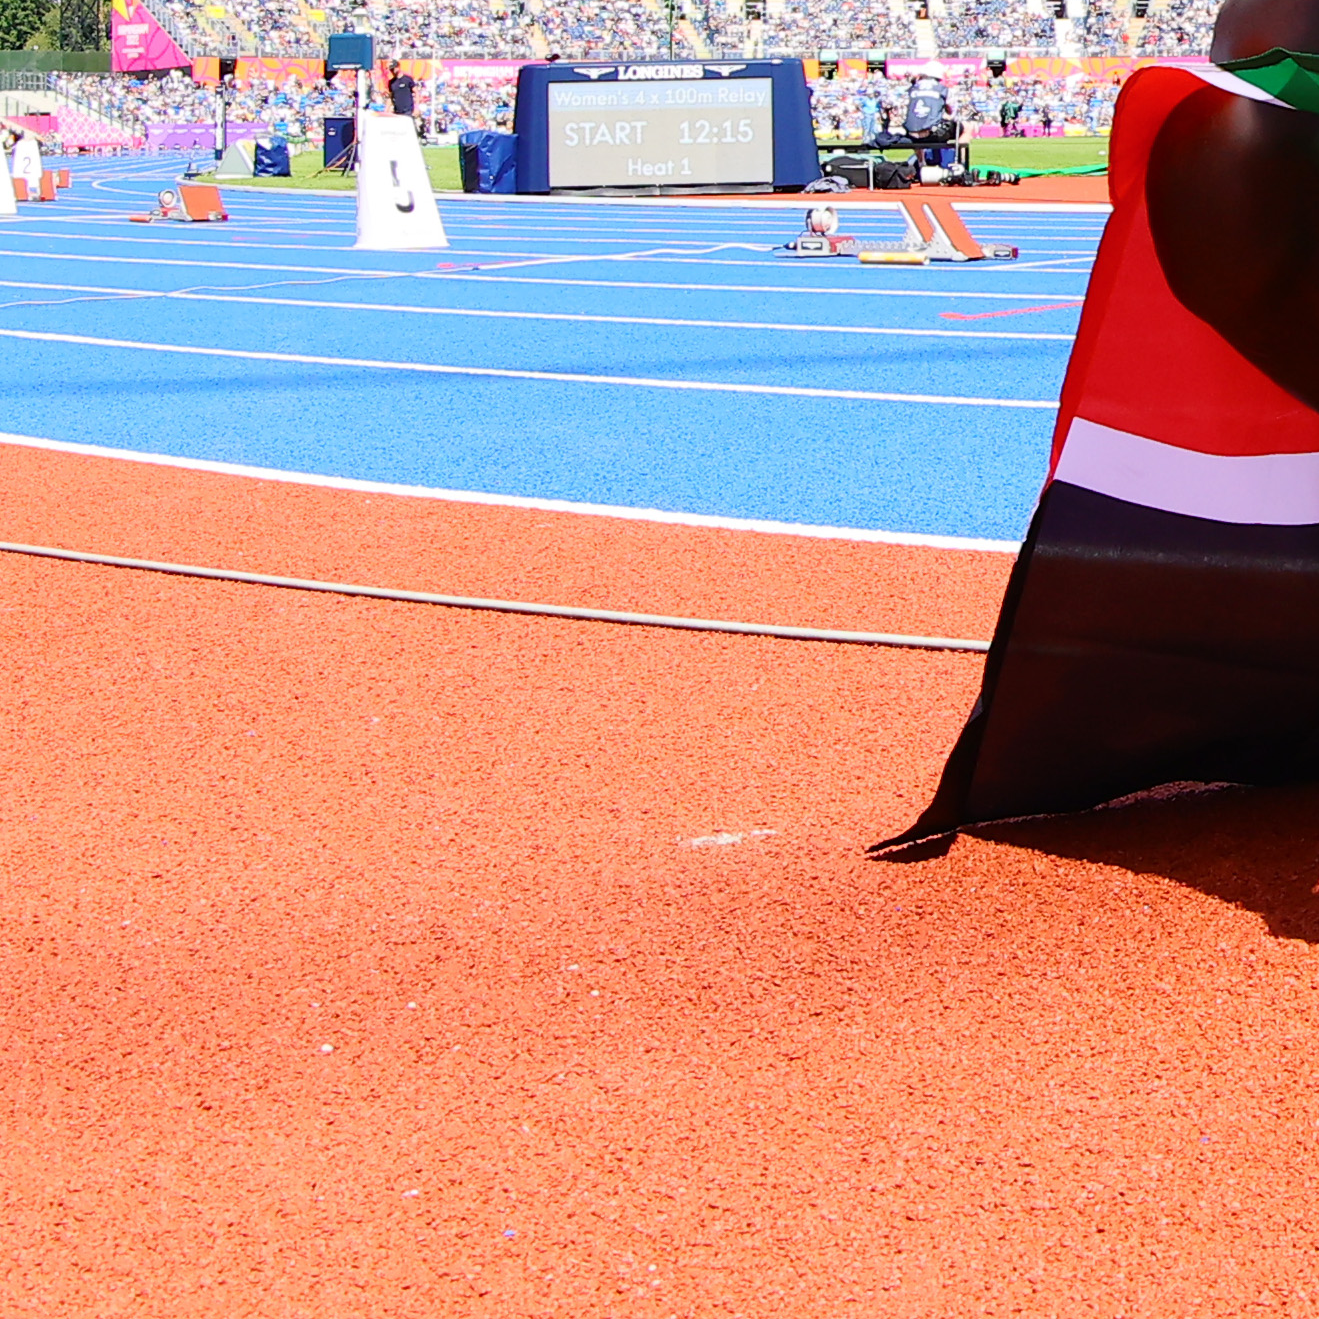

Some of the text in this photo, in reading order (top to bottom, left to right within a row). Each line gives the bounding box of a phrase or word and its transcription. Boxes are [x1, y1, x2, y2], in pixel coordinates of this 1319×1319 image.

[617, 64, 704, 80] LONGINES
[554, 87, 766, 107] Women's 4 x 100m Relay
[563, 118, 754, 147] START 12:15
[23, 156, 32, 174] 2
[627, 156, 692, 177] Heat 1
